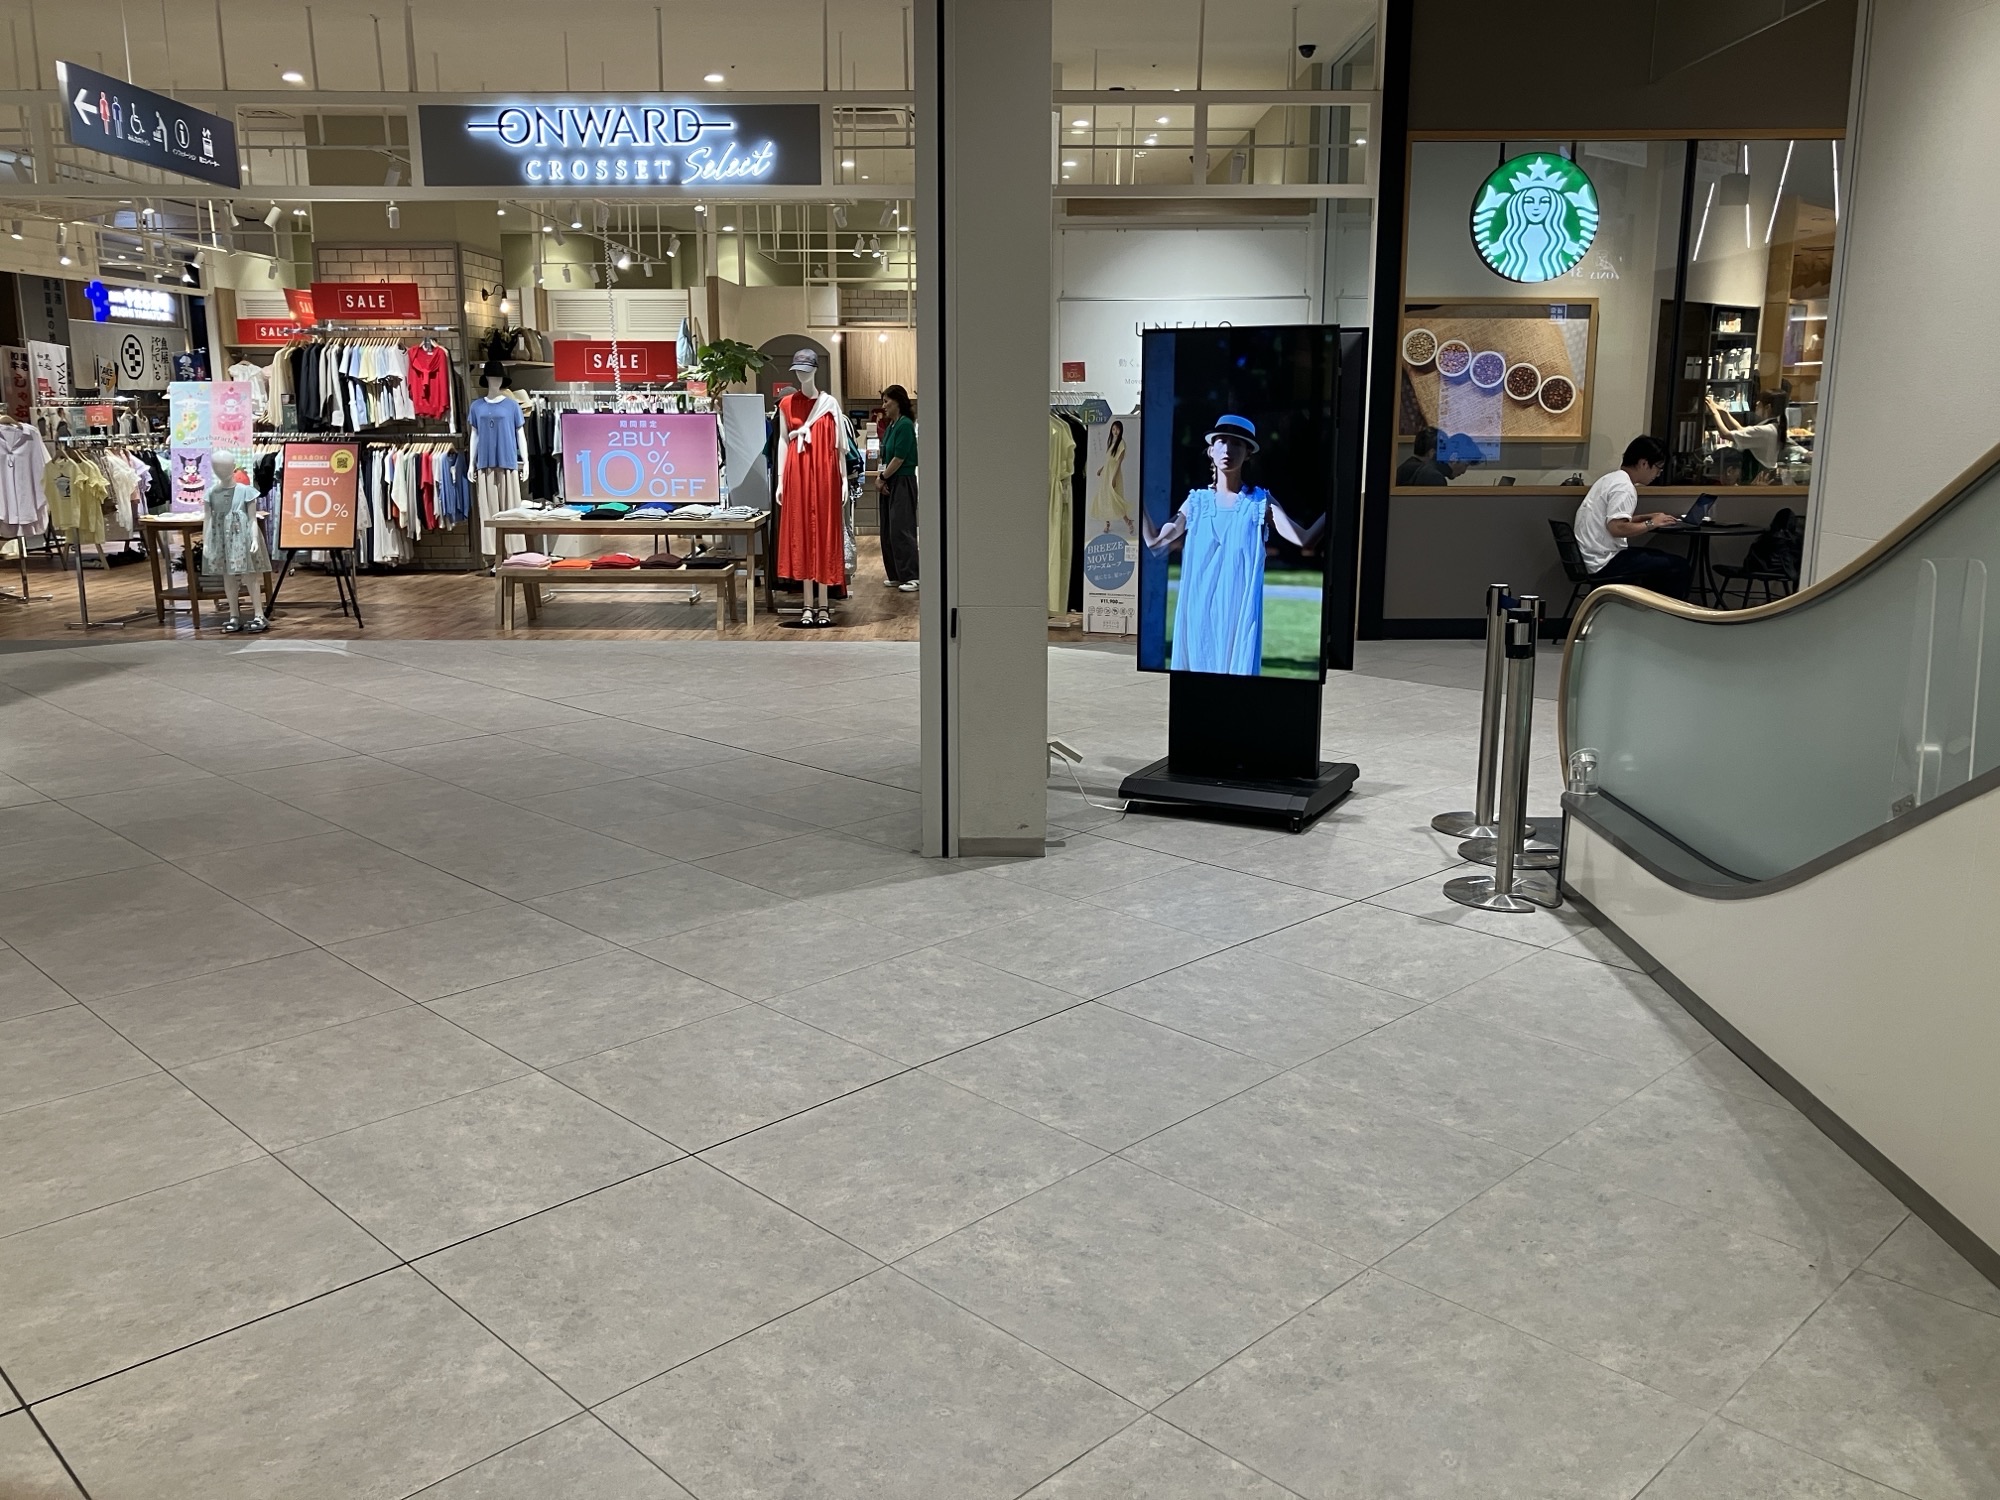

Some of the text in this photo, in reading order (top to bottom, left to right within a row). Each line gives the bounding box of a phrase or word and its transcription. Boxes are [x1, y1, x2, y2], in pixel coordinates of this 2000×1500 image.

[497, 106, 703, 148] ONWARD
[525, 141, 774, 185] CROSSET Select
[346, 294, 386, 308] SALE
[593, 353, 639, 369] SALE
[619, 420, 658, 429] 期間限定
[608, 431, 671, 447] 2BUY
[576, 449, 706, 498] 10% OFF
[302, 477, 340, 486] 2BUY
[292, 490, 349, 519] 10%
[299, 522, 337, 536] OFF
[1087, 541, 1124, 554] BREEZE
[1087, 552, 1115, 565] MOVE
